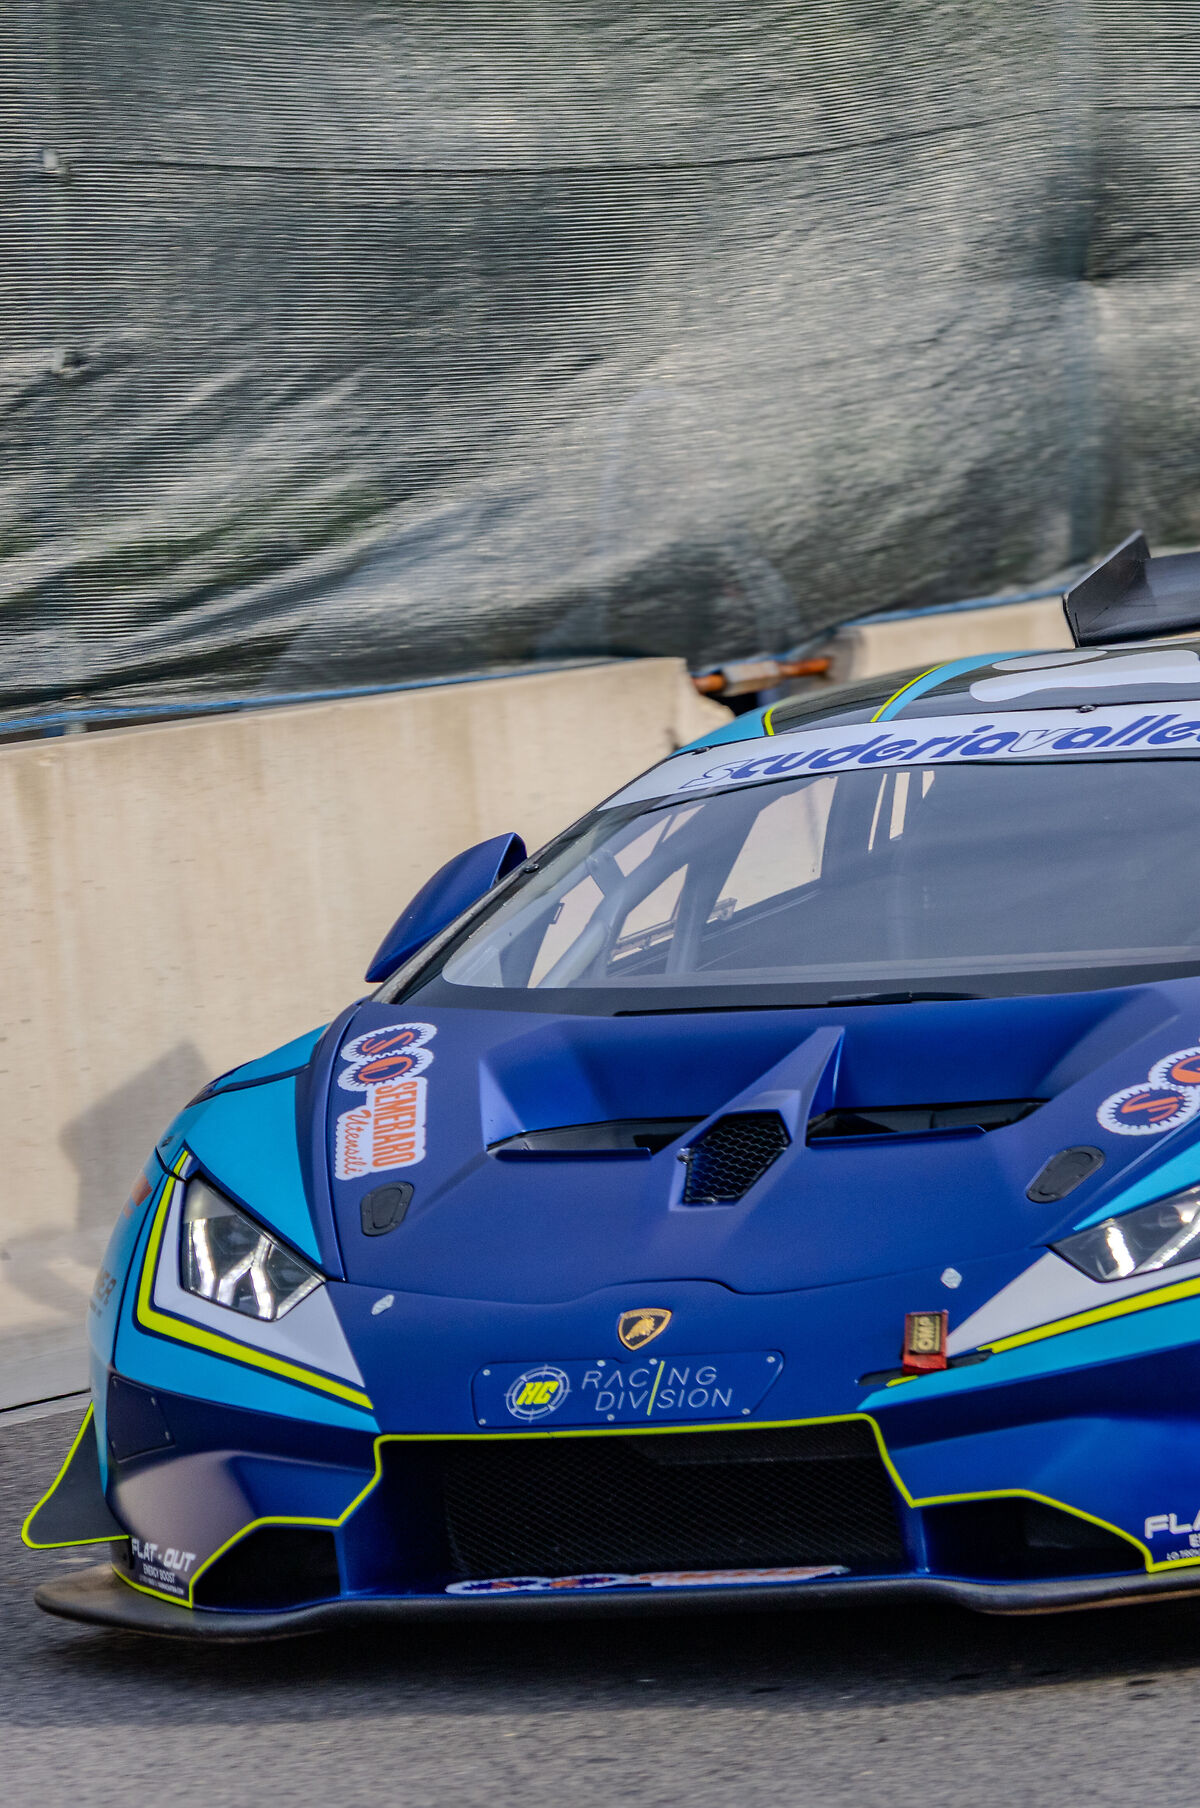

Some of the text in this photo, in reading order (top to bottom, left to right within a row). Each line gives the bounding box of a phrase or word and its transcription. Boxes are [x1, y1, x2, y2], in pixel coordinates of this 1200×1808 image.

[372, 1081, 418, 1168] SEMERARO
[343, 1109, 371, 1175] Utensili
[917, 1316, 936, 1350] OMP
[581, 1363, 718, 1391] RACING
[595, 1387, 733, 1413] DIVISION
